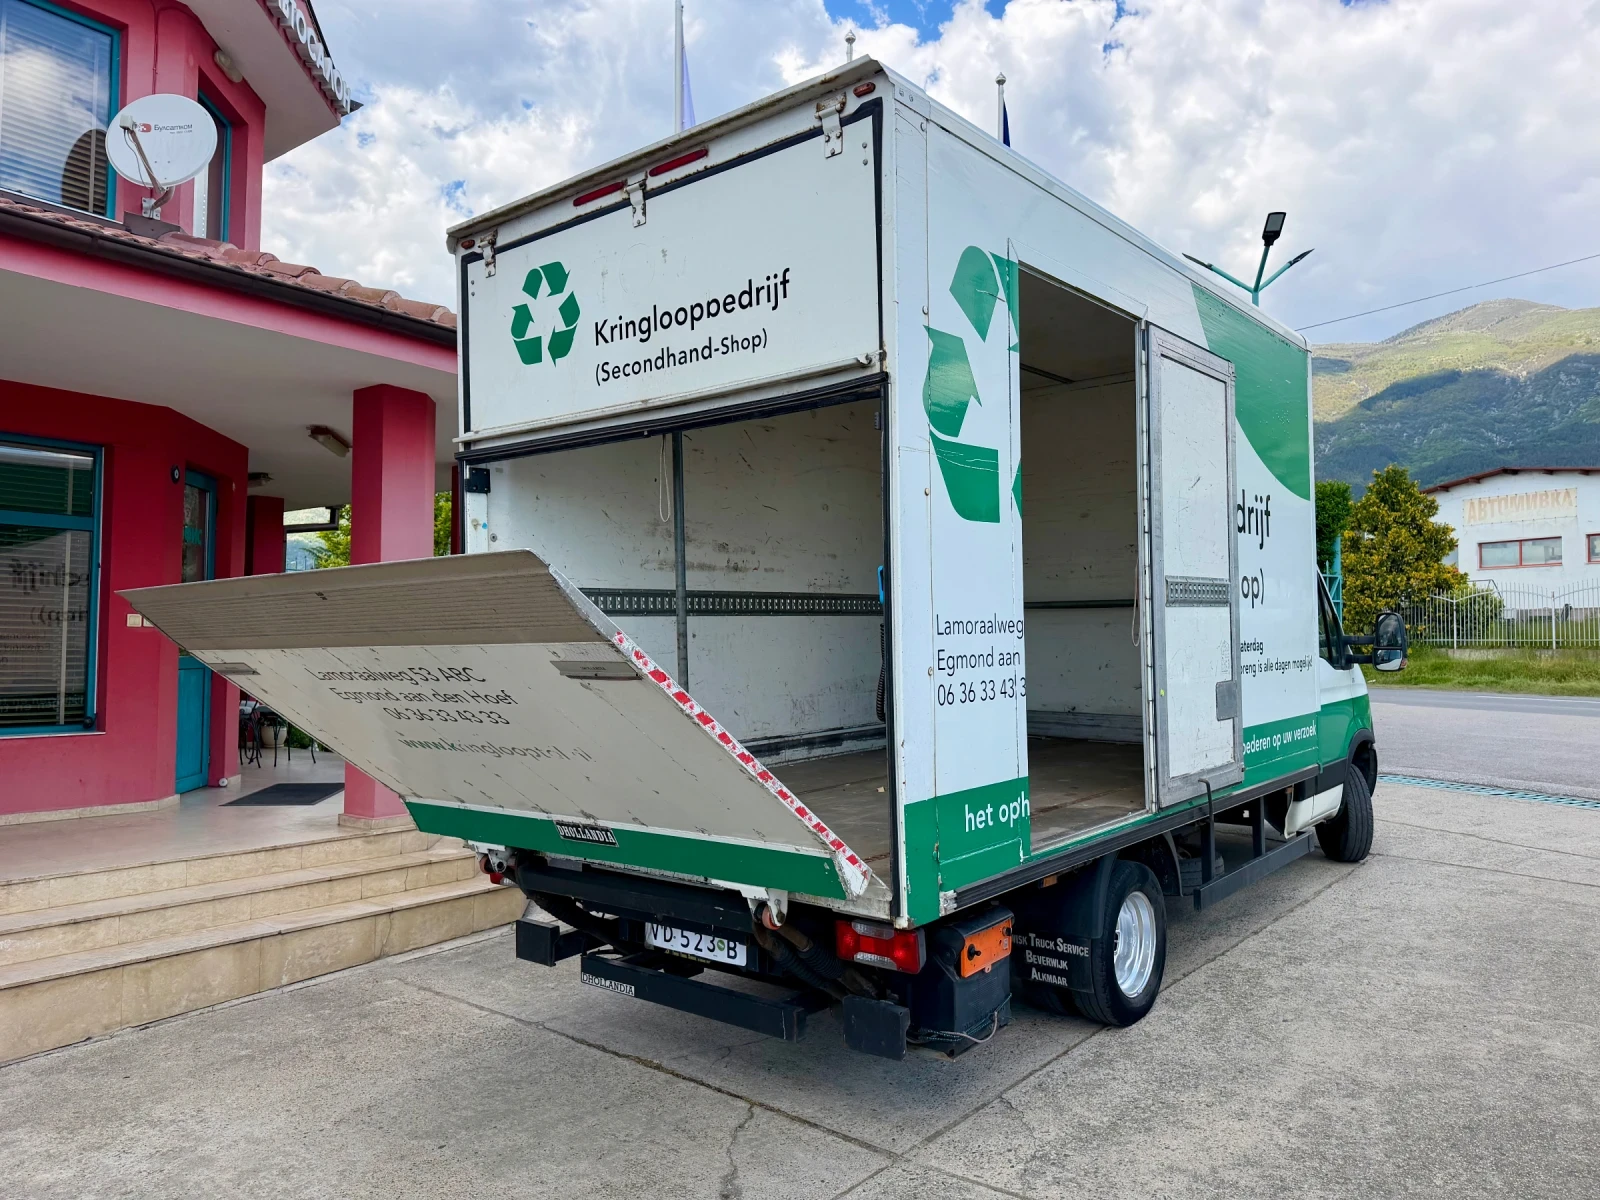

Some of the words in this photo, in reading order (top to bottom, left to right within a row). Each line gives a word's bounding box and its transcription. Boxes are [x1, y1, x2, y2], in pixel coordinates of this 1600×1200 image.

[595, 328, 767, 386] (Secondhand-Shop)
[936, 612, 1024, 639] Lamoraalweg
[937, 645, 994, 677] Egmond
[998, 651, 1021, 667] aan
[1257, 659, 1263, 673] is
[1263, 657, 1274, 672] alle
[1274, 657, 1292, 674] dagen
[304, 666, 419, 685] Lamoraalweg
[408, 667, 440, 682] 53
[438, 667, 486, 683] ABC
[329, 687, 400, 703] Egmond
[399, 691, 429, 703] aan
[431, 688, 470, 704] den
[463, 689, 518, 705] Hoef
[937, 683, 955, 706] 06
[959, 681, 976, 704] 36
[980, 679, 996, 701] 33
[1000, 678, 1015, 698] 43
[383, 707, 411, 720] 06
[405, 708, 434, 721] 36
[428, 708, 458, 722] 33
[456, 710, 484, 724] 43
[479, 710, 510, 725] 33
[1272, 733, 1282, 751] op
[1282, 730, 1293, 744] uw
[1293, 719, 1317, 741] verzoek
[964, 803, 994, 833] het
[556, 824, 615, 843] DHOLLANDIA
[1029, 932, 1056, 950] TRUCK
[1056, 937, 1090, 957] SERVICE
[1025, 949, 1069, 971] BEVERWIJK
[582, 973, 634, 996] DHOLLANDIA
[1031, 967, 1068, 986] ALKMAAR
